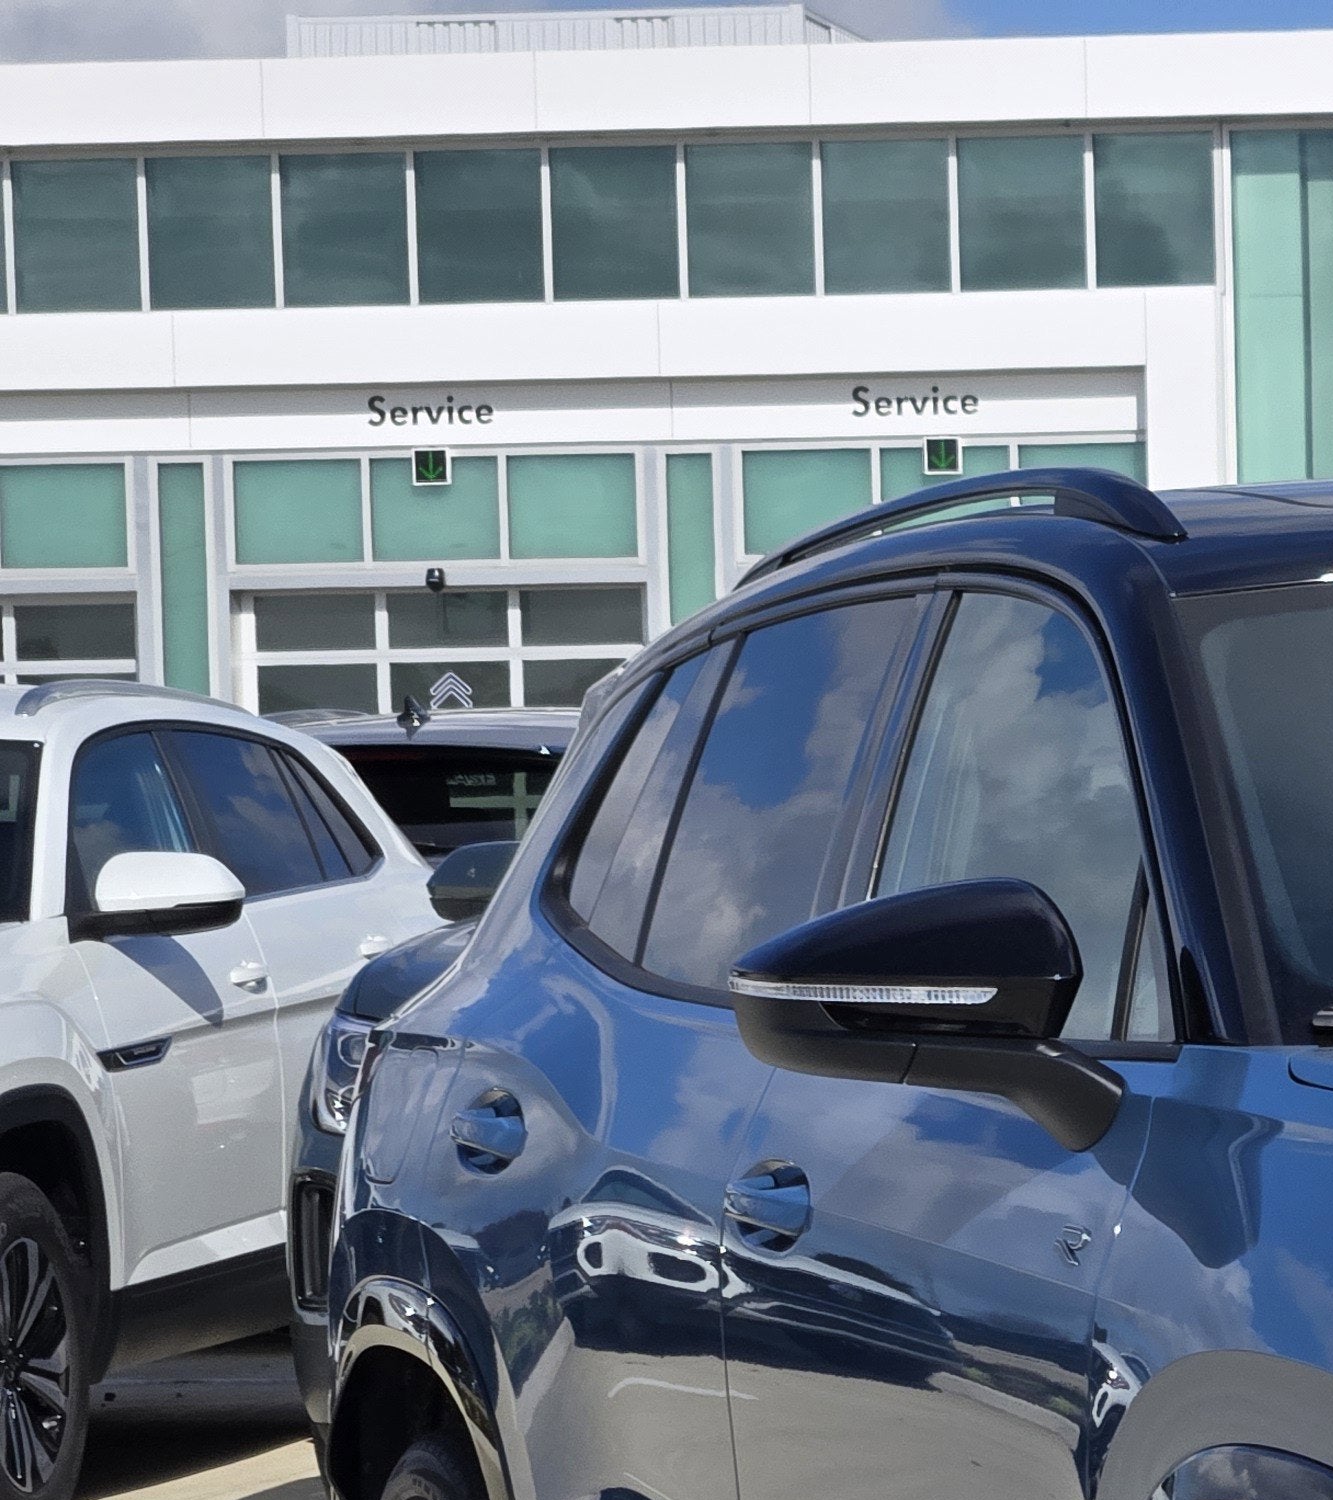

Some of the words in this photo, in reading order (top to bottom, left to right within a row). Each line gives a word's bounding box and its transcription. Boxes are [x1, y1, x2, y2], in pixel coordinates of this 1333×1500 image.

[367, 395, 494, 427] Service
[852, 386, 979, 417] Service
[1054, 1224, 1092, 1267] R
